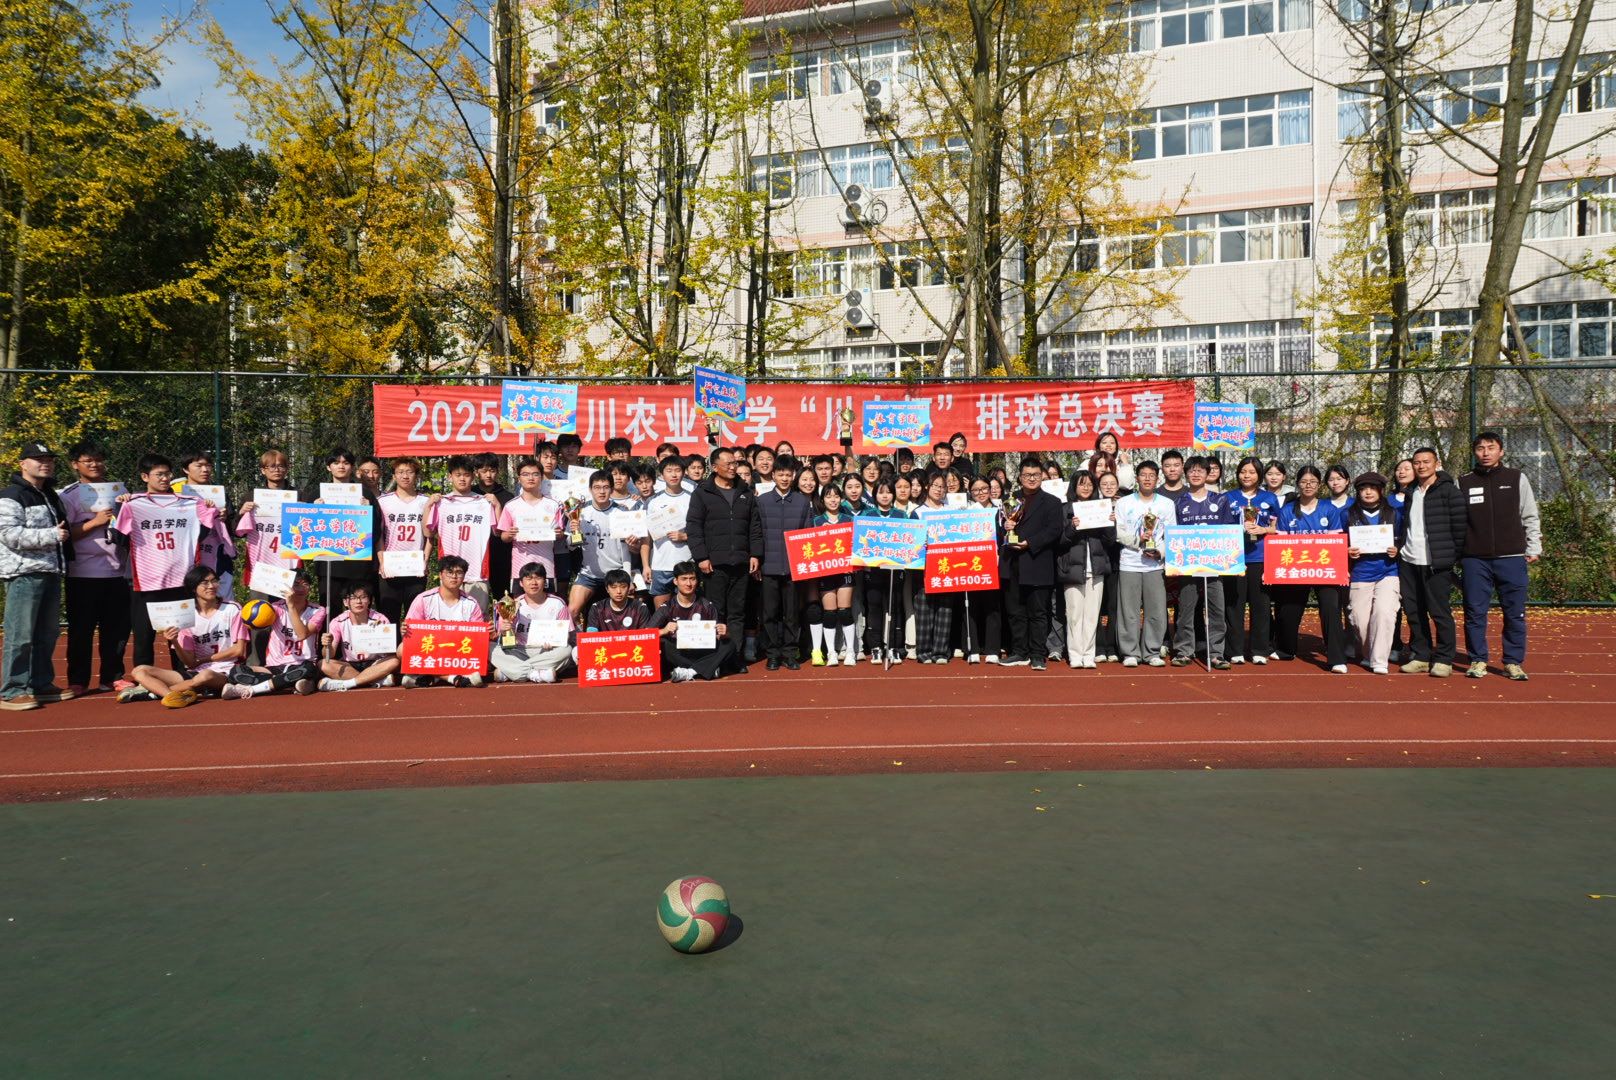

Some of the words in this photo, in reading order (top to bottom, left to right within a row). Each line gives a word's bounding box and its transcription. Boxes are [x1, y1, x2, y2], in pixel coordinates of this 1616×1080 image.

[407, 390, 1165, 445] 2025川农业学“川”排球总决赛
[874, 411, 920, 425] 体育学院
[871, 427, 924, 439] 女子排球队
[140, 518, 188, 531] 食品学院
[300, 518, 358, 533] 食品学院
[446, 513, 484, 524] 食品学院
[155, 531, 176, 551] 35
[293, 534, 365, 549] 男子排球队
[397, 525, 416, 542] 32
[458, 525, 471, 542] 10
[865, 528, 916, 545] 研究生院
[801, 538, 846, 560] 第二名
[860, 546, 920, 560] 女子排球队
[1280, 548, 1332, 566] 第三名
[937, 556, 983, 575] 第一名
[1275, 567, 1336, 579] 奖金800元
[930, 573, 993, 588] 奖金1500元
[420, 633, 473, 655] 第一名
[409, 655, 481, 670] 奖金1500元
[594, 645, 645, 666] 第一名
[585, 665, 654, 681] 奖金1500元
